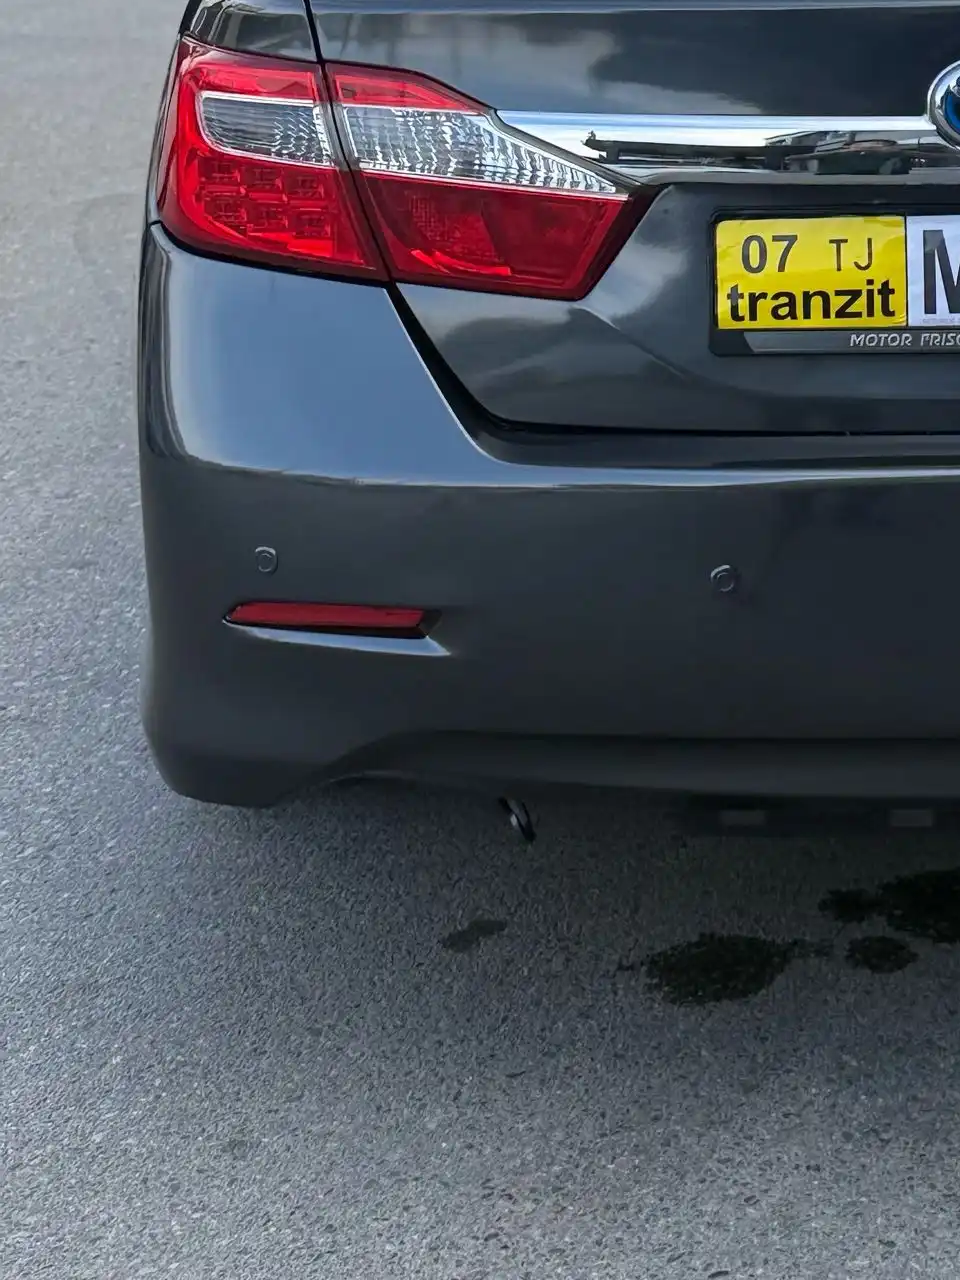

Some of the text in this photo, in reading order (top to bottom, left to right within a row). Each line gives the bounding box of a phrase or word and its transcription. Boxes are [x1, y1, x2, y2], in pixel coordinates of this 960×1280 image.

[740, 234, 873, 274] 07 TJ
[727, 278, 896, 322] tranzit
[849, 333, 912, 347] MOTOR
